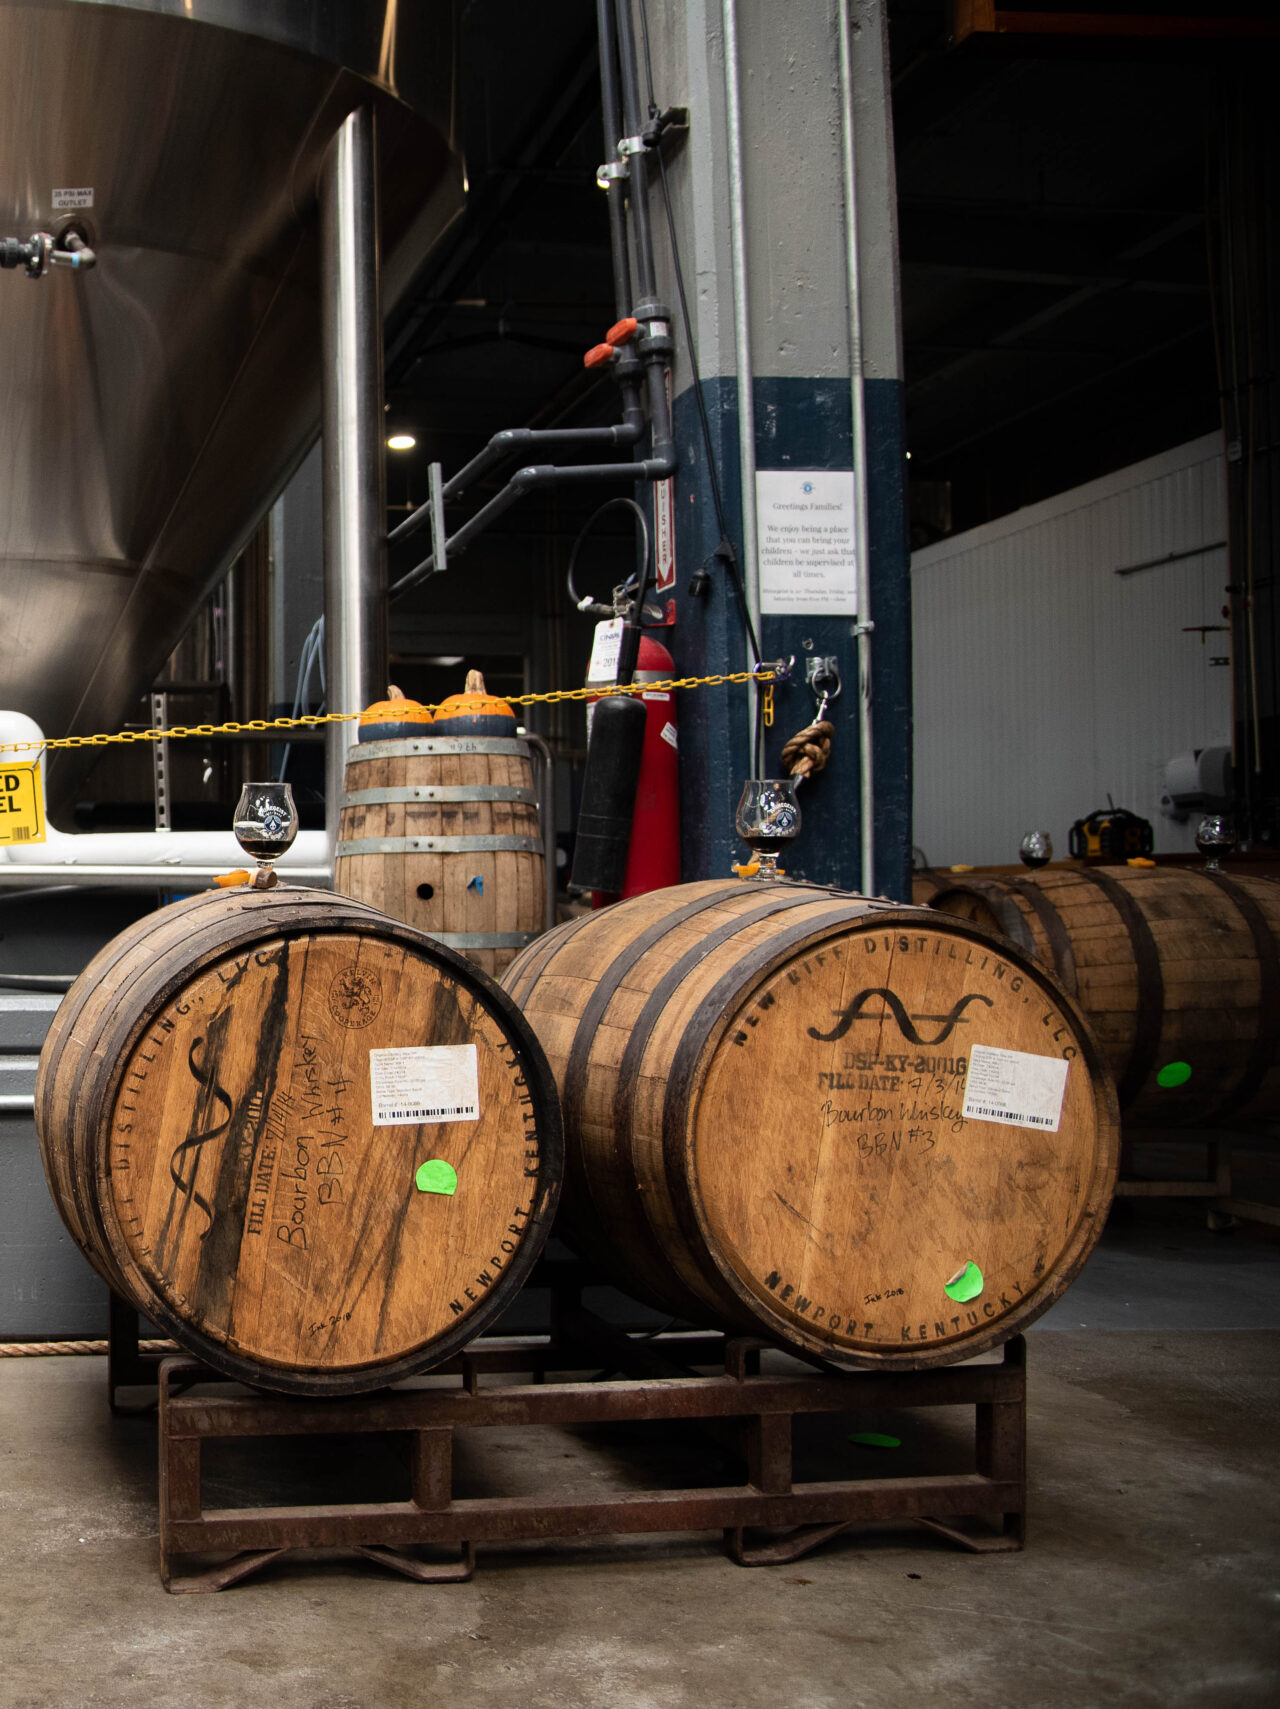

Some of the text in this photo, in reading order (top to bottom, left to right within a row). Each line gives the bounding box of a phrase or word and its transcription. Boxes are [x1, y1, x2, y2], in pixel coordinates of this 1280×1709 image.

[772, 502, 843, 511] Greetings Families!
[766, 536, 780, 544] that
[812, 536, 832, 545] bring
[767, 525, 778, 533] We
[780, 525, 800, 534] enjoy
[802, 525, 822, 534] being
[830, 525, 849, 534] place
[761, 547, 792, 555] children
[763, 559, 794, 567] children
[806, 559, 846, 568] supervised
[793, 570, 802, 578] all
[818, 1072, 854, 1090] FILL
[496, 1042, 540, 1179] KENTUCKY
[821, 1100, 968, 1133] Bourbon Whiskey
[277, 1035, 328, 1250] Bourbon Whiskey
[857, 1130, 902, 1159] BBN
[317, 1130, 348, 1205] BBN
[247, 1199, 267, 1236] FILL
[764, 1271, 1025, 1341] NEWPORT KENTUCKY
